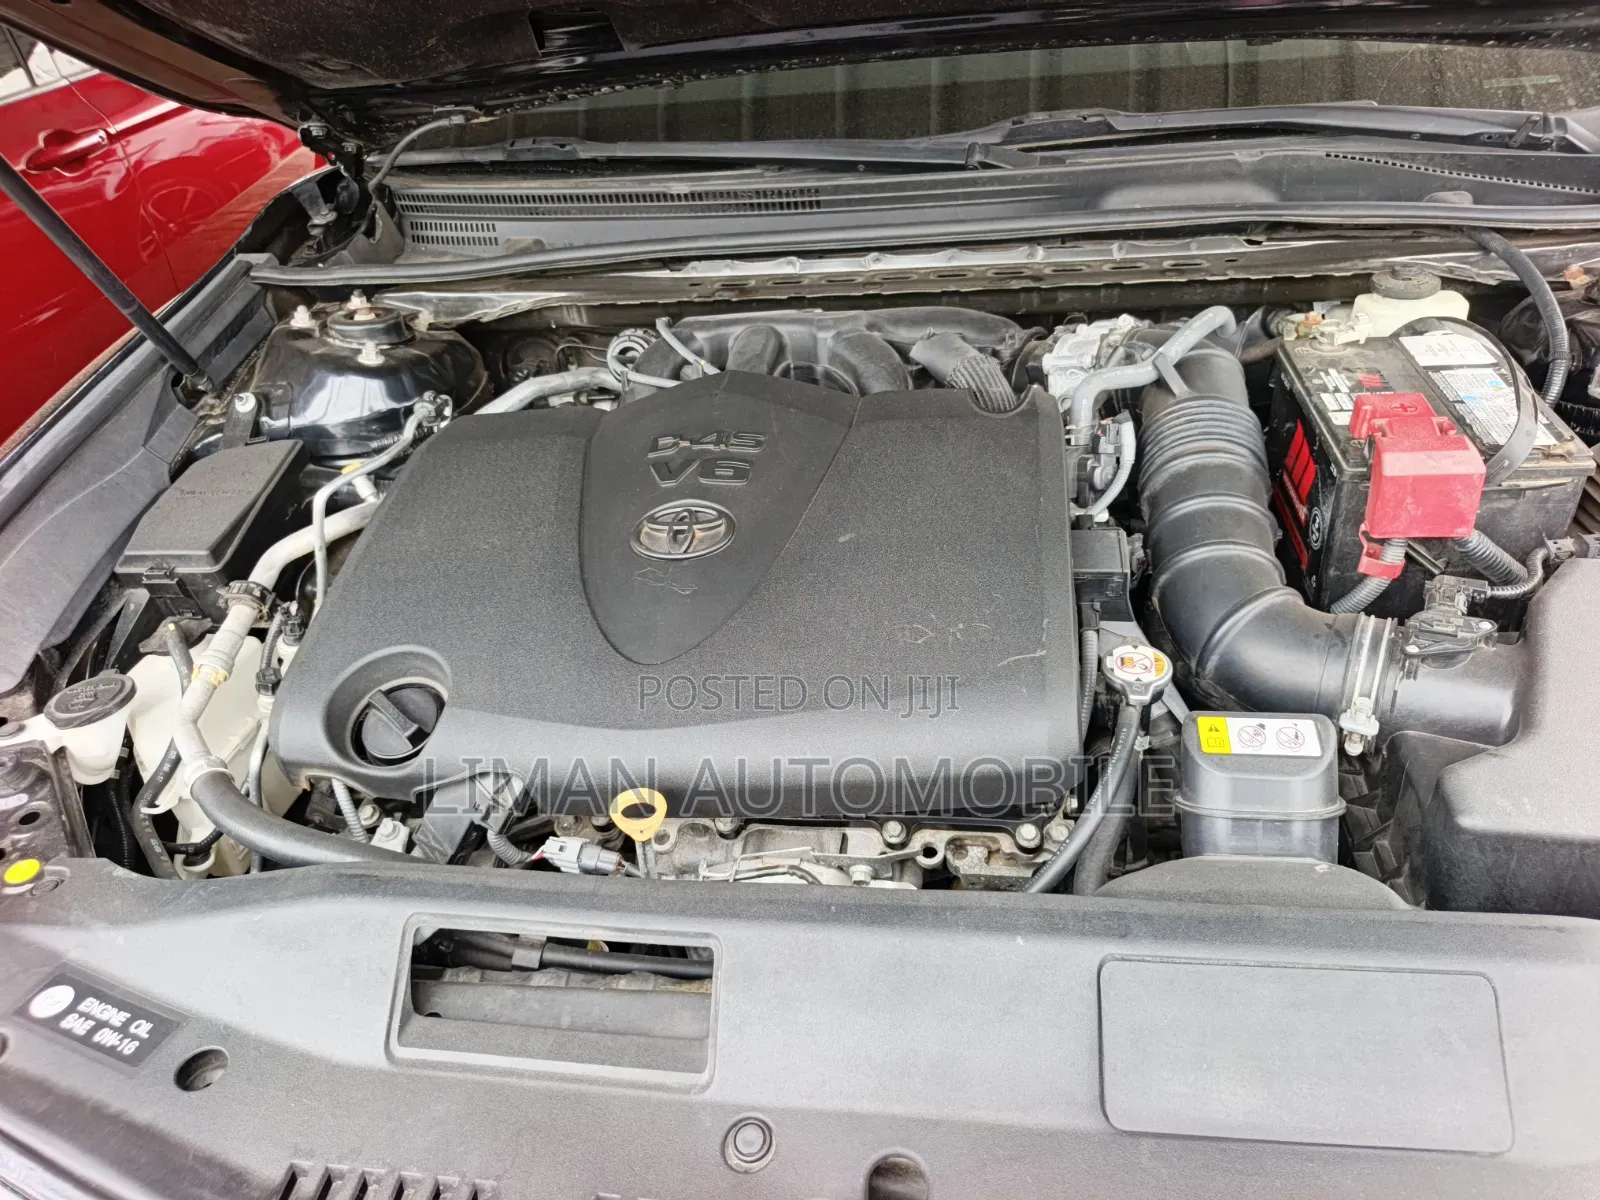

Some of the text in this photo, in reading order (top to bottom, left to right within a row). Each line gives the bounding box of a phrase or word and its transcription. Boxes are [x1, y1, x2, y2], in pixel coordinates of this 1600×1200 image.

[649, 457, 753, 487] V6
[59, 1013, 140, 1055] SAE 0W-16
[77, 997, 154, 1038] ENGINE OIL
